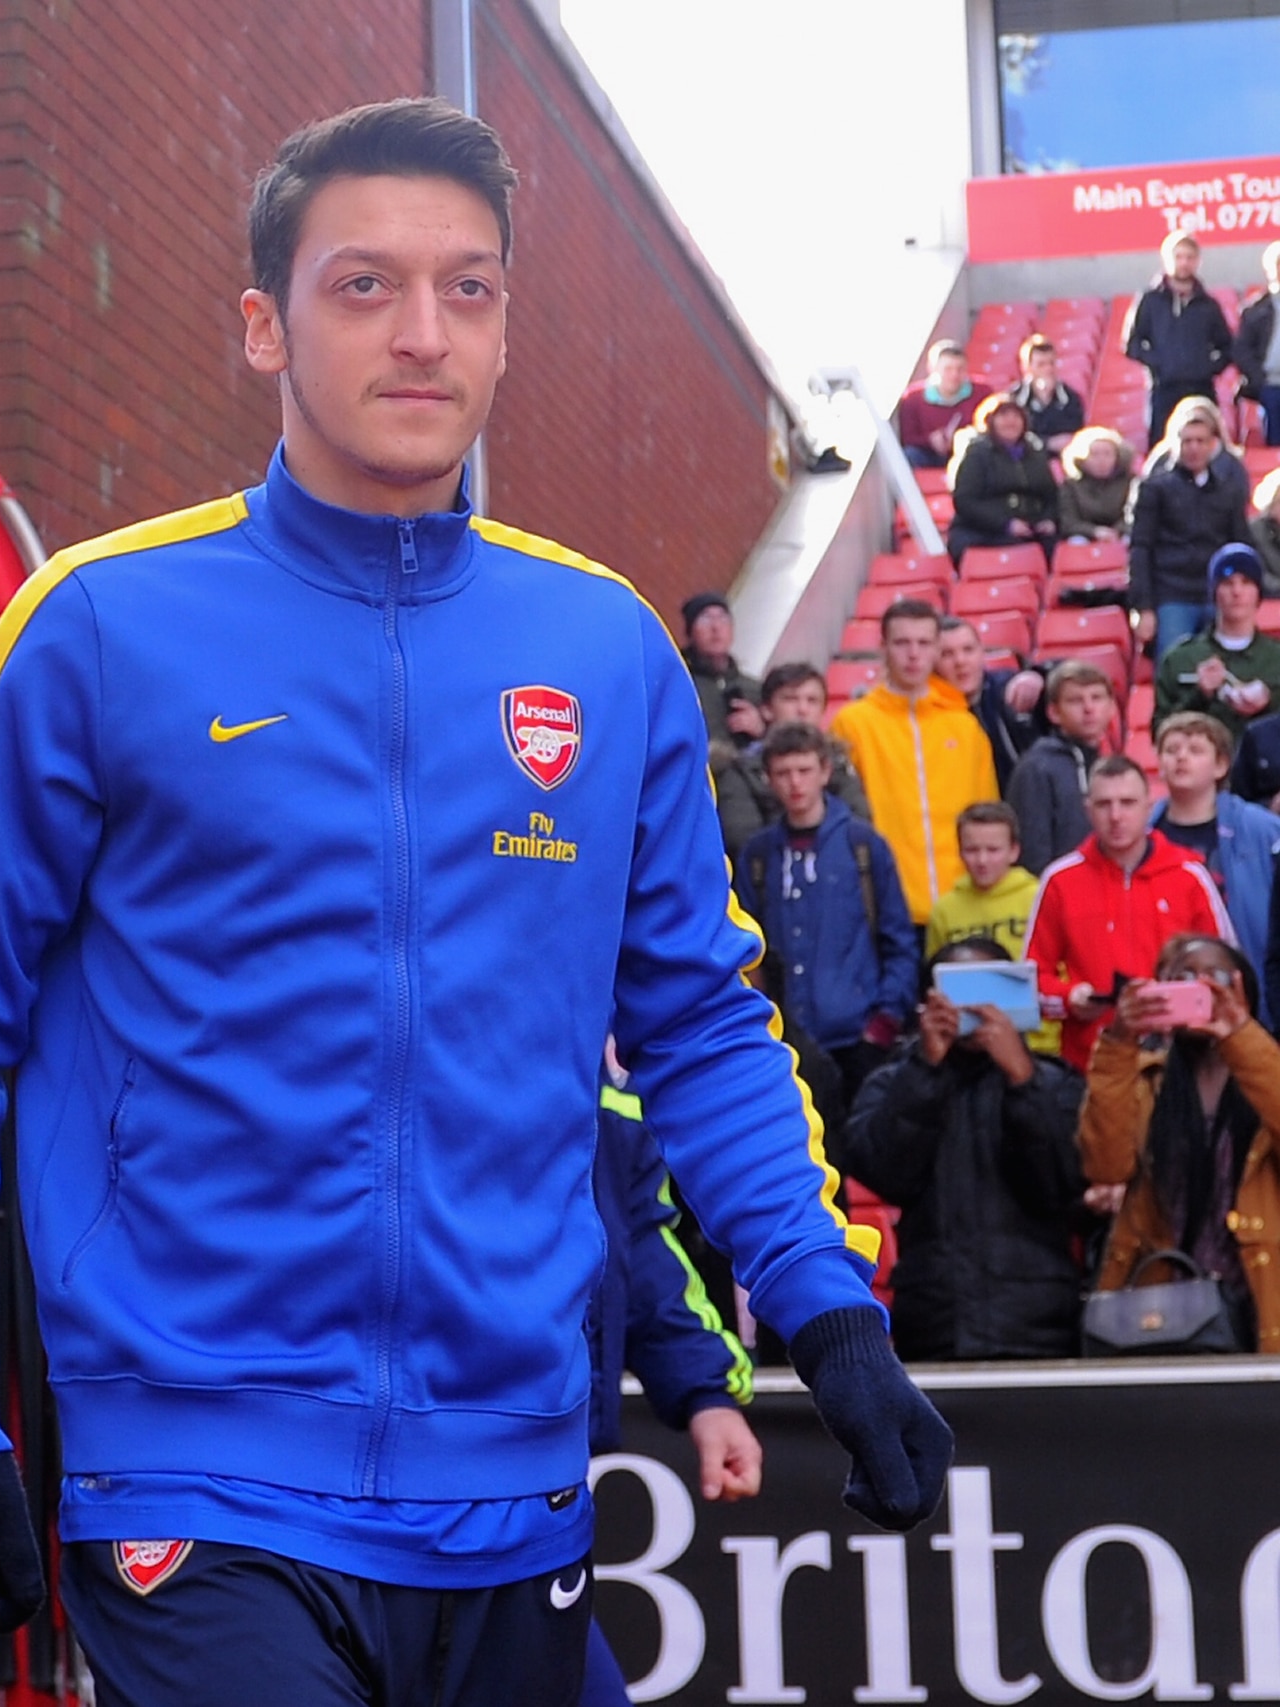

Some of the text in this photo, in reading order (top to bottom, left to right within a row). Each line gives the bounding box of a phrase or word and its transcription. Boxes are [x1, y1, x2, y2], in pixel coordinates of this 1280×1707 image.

[1073, 182, 1143, 213] Main
[1146, 178, 1225, 207] Event
[1162, 204, 1215, 235] Tel.
[515, 701, 570, 723] Arsenal
[529, 811, 554, 836] Fly
[493, 831, 578, 863] Emirates
[586, 1452, 1280, 1706] Brita
